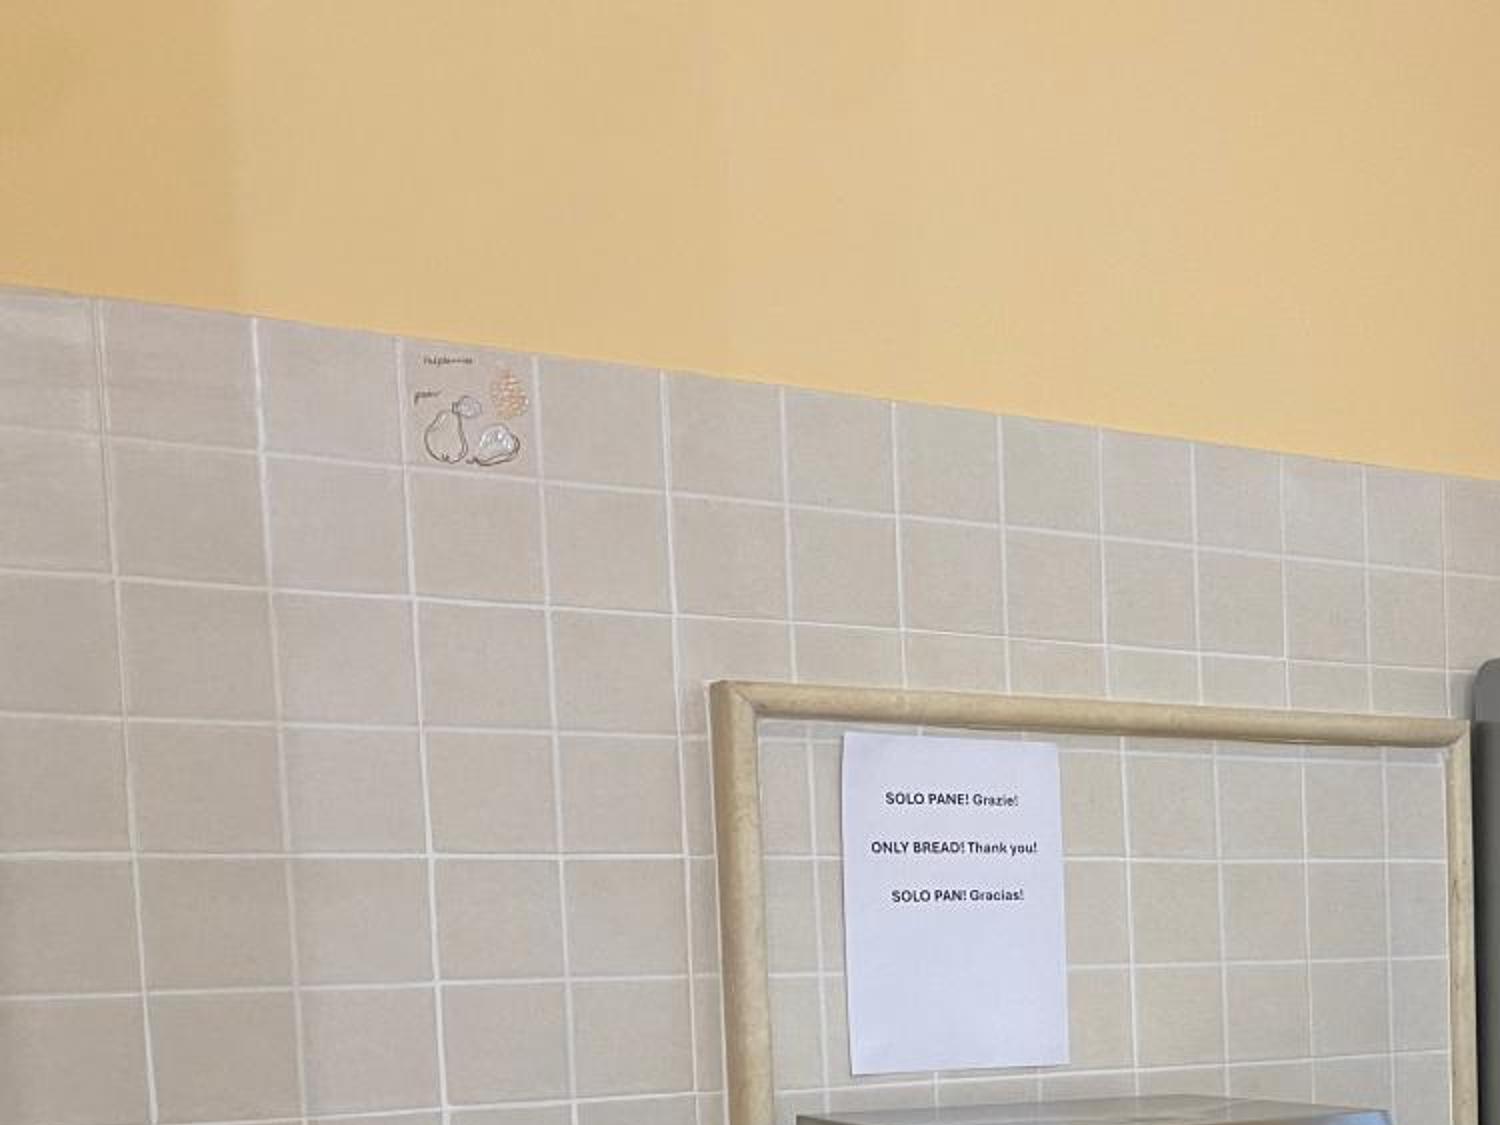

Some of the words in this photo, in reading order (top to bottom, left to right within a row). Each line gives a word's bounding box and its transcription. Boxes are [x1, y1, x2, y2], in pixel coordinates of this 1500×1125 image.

[885, 791, 925, 806] SOLO
[928, 792, 969, 806] PANE!
[972, 793, 1019, 807] Grazie!
[871, 841, 909, 854] ONLY
[913, 841, 965, 854] BREAD!
[968, 841, 1007, 854] Thank
[1010, 841, 1038, 857] you!
[891, 889, 931, 903] SOLO
[934, 889, 967, 901] PAN!
[969, 888, 1025, 902] Gracias!
